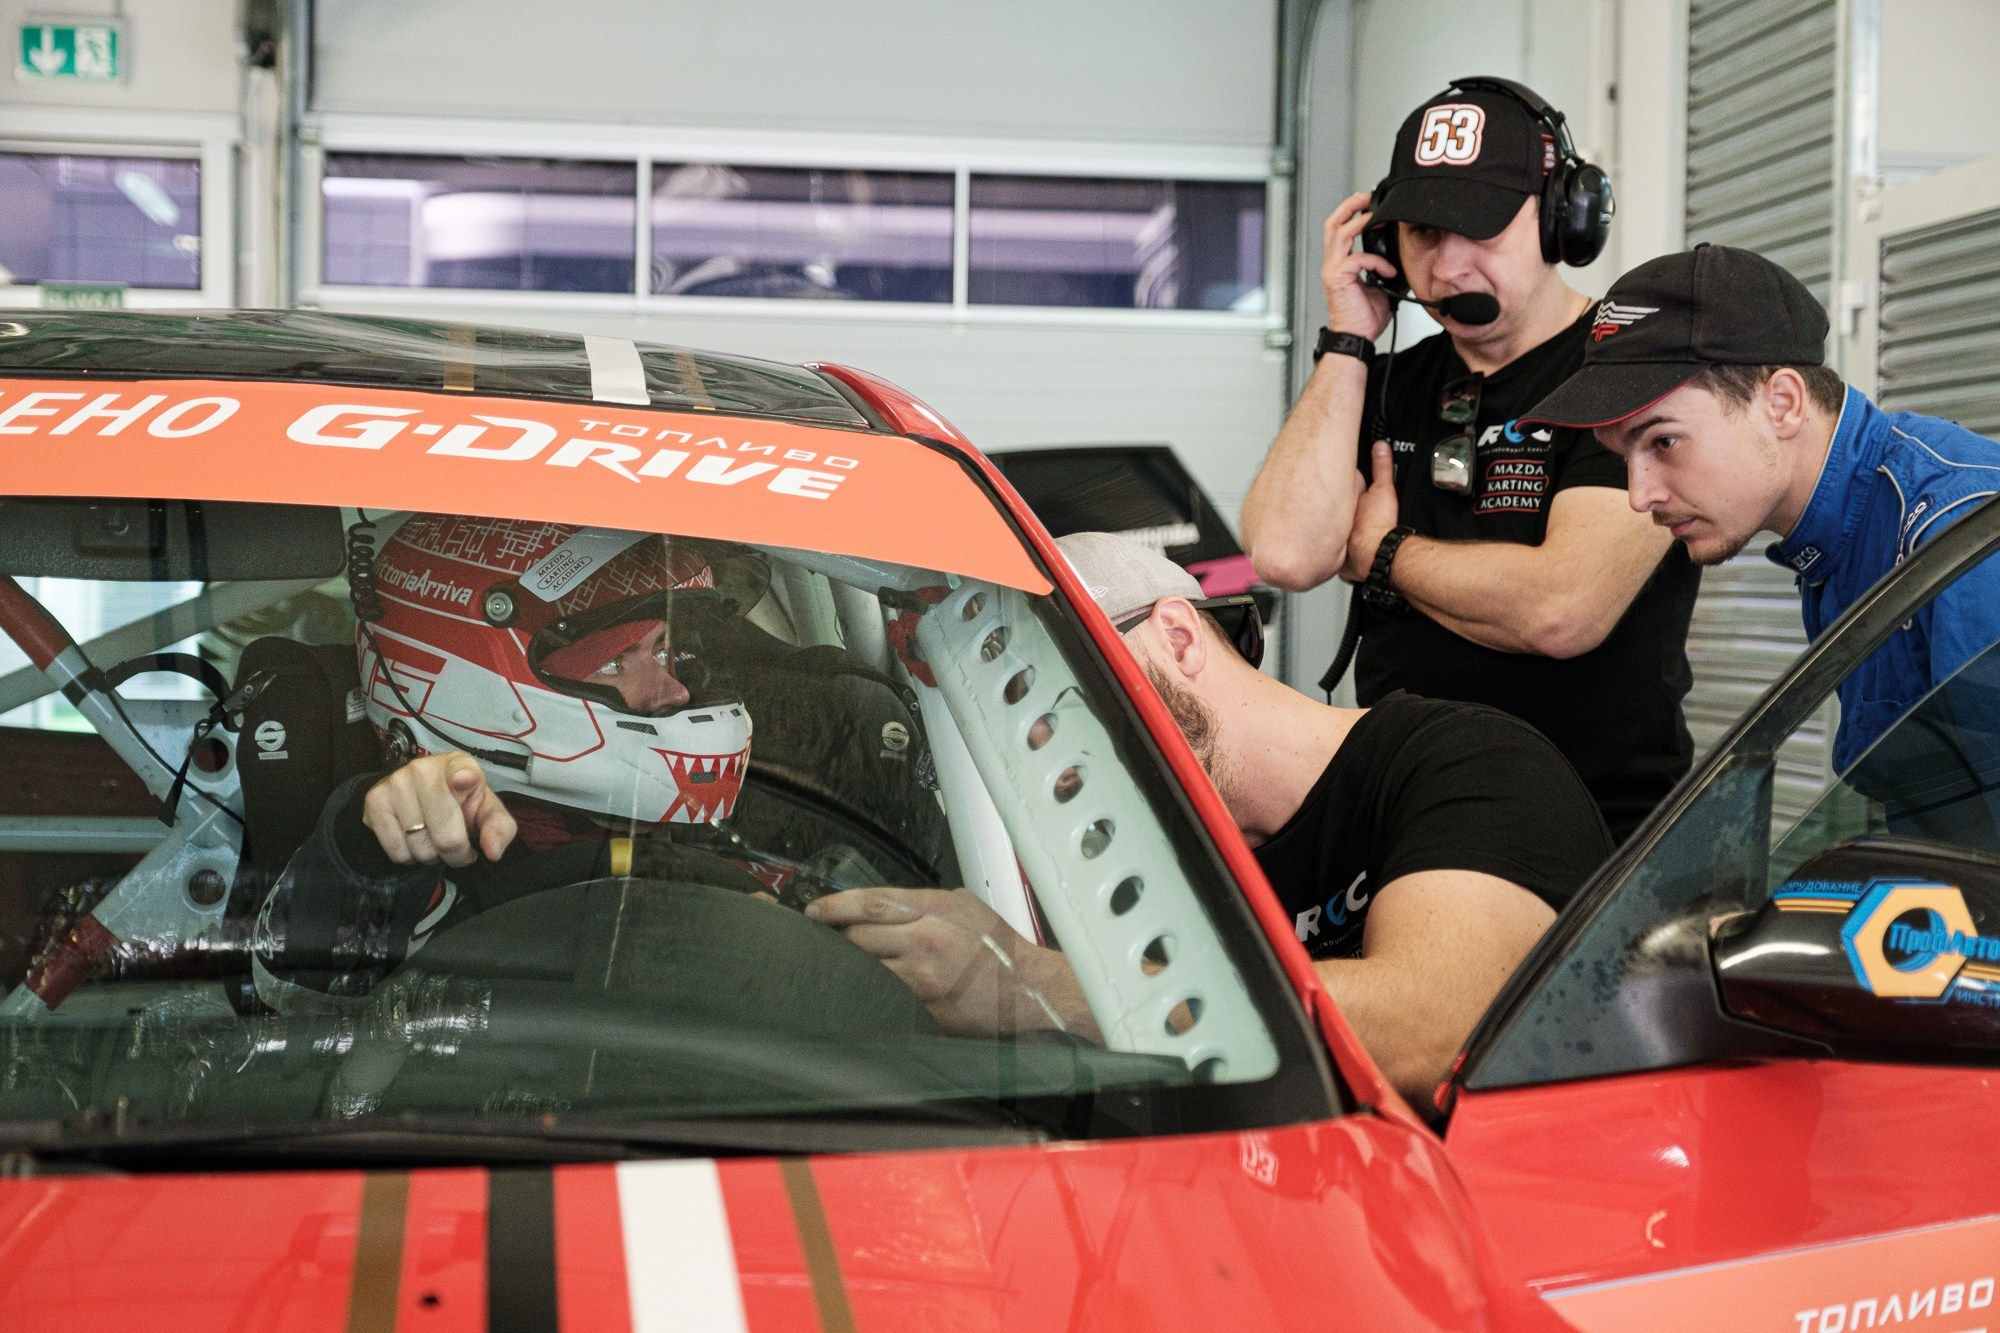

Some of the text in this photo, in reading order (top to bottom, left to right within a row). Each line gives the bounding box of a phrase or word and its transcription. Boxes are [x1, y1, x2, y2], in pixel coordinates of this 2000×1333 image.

[1416, 105, 1484, 165] 53
[0, 392, 240, 438] ЕНО
[579, 419, 859, 470] ТОПЛИВО
[1493, 463, 1544, 476] MAZDA
[1486, 479, 1544, 493] KARTING
[1479, 496, 1542, 509] ACADEMY
[538, 553, 566, 578] MAZDA
[544, 557, 575, 585] KARTING
[552, 559, 587, 591] ACADEMY
[1795, 1277, 1995, 1333] ТОПЛИВО
